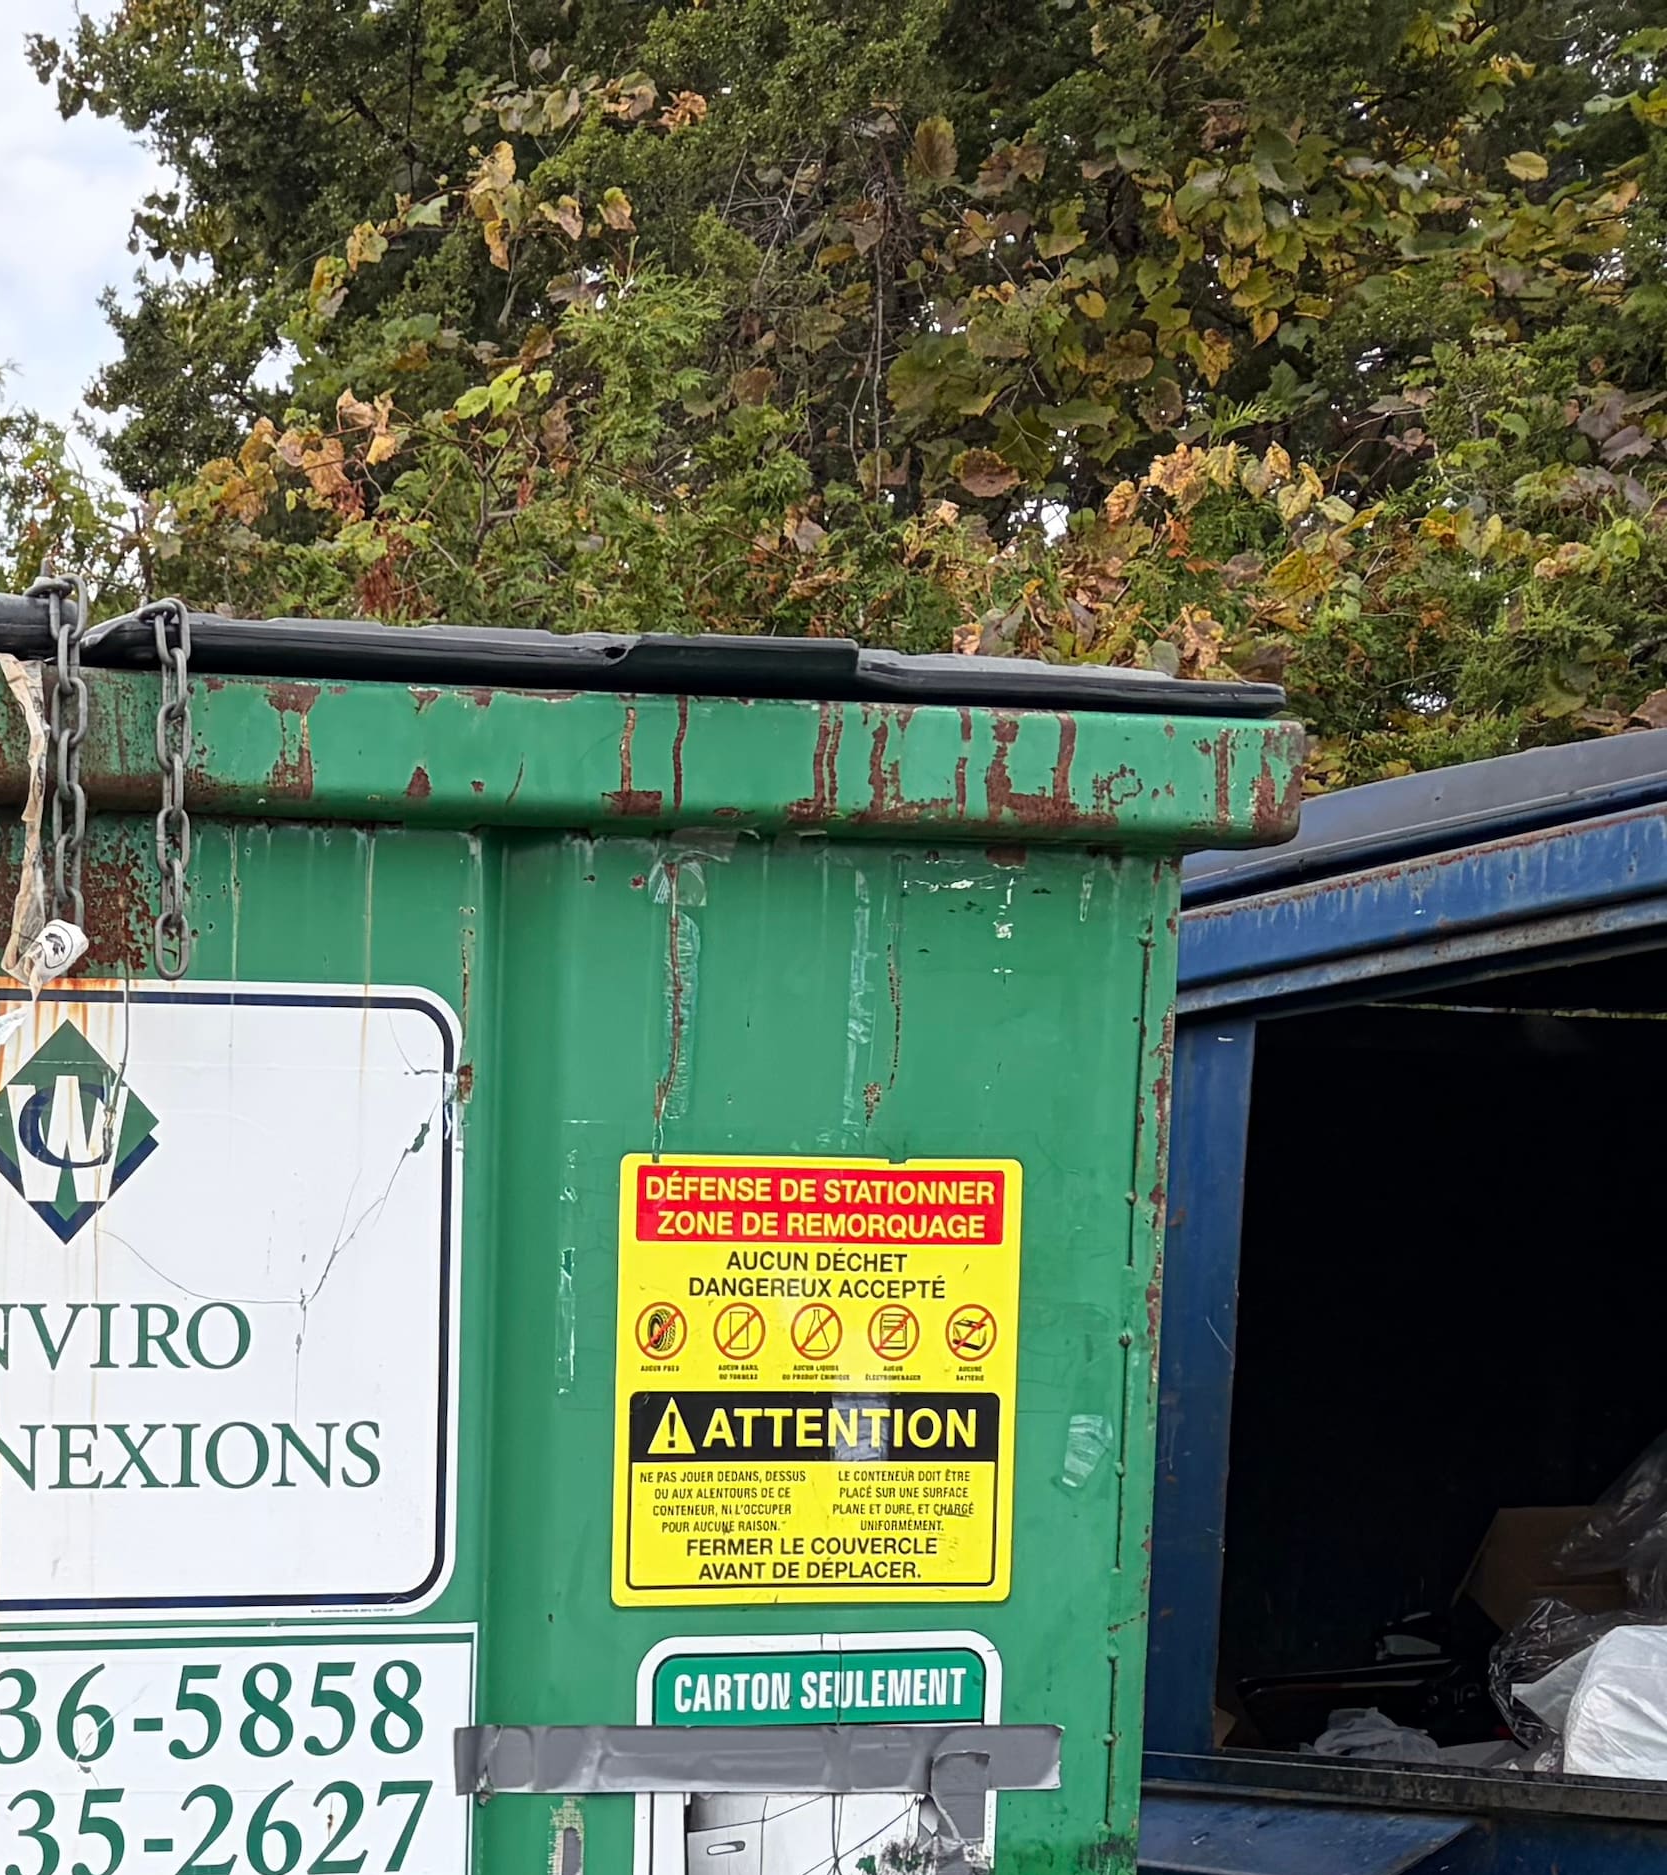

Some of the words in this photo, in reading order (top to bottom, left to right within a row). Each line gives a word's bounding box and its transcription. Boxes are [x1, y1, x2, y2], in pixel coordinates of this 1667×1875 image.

[646, 1171, 772, 1203] DÉFENSE
[779, 1181, 815, 1203] DE
[823, 1182, 995, 1204] STATIONNER
[657, 1211, 733, 1236] ZONE
[742, 1212, 778, 1236] DE
[787, 1213, 985, 1239] REMORQUAGE
[726, 1250, 810, 1271] AUCUN
[816, 1247, 907, 1273] DÉCHET
[689, 1277, 832, 1299] DANGEREUX
[838, 1275, 946, 1299] ACCEPTÉ
[702, 1407, 976, 1448] ATTENTION
[640, 1472, 654, 1482] NE
[657, 1471, 677, 1482] PAS
[680, 1471, 714, 1482] JOUER
[717, 1471, 763, 1483] DEDANS,
[765, 1471, 806, 1482] DESSUS
[838, 1471, 850, 1481] LE
[854, 1470, 914, 1481] CONTENEUR
[918, 1471, 941, 1481] DOIT
[655, 1488, 669, 1499] OU
[671, 1488, 693, 1499] AUX
[696, 1488, 758, 1499] ALENTOURS
[761, 1487, 775, 1498] DE
[778, 1487, 791, 1498] CE
[840, 1486, 872, 1498] PLACÉ
[876, 1488, 895, 1498] SUR
[899, 1488, 919, 1498] UNE
[923, 1487, 968, 1498] SURFACE
[653, 1505, 719, 1517] CONTENEUR,
[722, 1505, 733, 1516] NI
[833, 1504, 865, 1514] PLANE
[869, 1504, 881, 1514] ET
[885, 1504, 915, 1515] DURE,
[918, 1504, 930, 1514] ET
[934, 1502, 974, 1516] CHARGÉ
[662, 1521, 691, 1533] POUR
[693, 1521, 735, 1532] AUCUNE
[738, 1521, 780, 1532] RAISON.
[861, 1518, 944, 1531] UNIFORMÉMENT.
[687, 1539, 773, 1556] FERMER
[779, 1539, 805, 1555] LE
[810, 1537, 937, 1555] COUVERCLE
[699, 1562, 766, 1580] AVANT
[772, 1562, 799, 1579] DE
[806, 1558, 921, 1579] DÉPLACER.
[674, 1672, 792, 1714] CARTON
[800, 1667, 966, 1710] SEULEMENT
